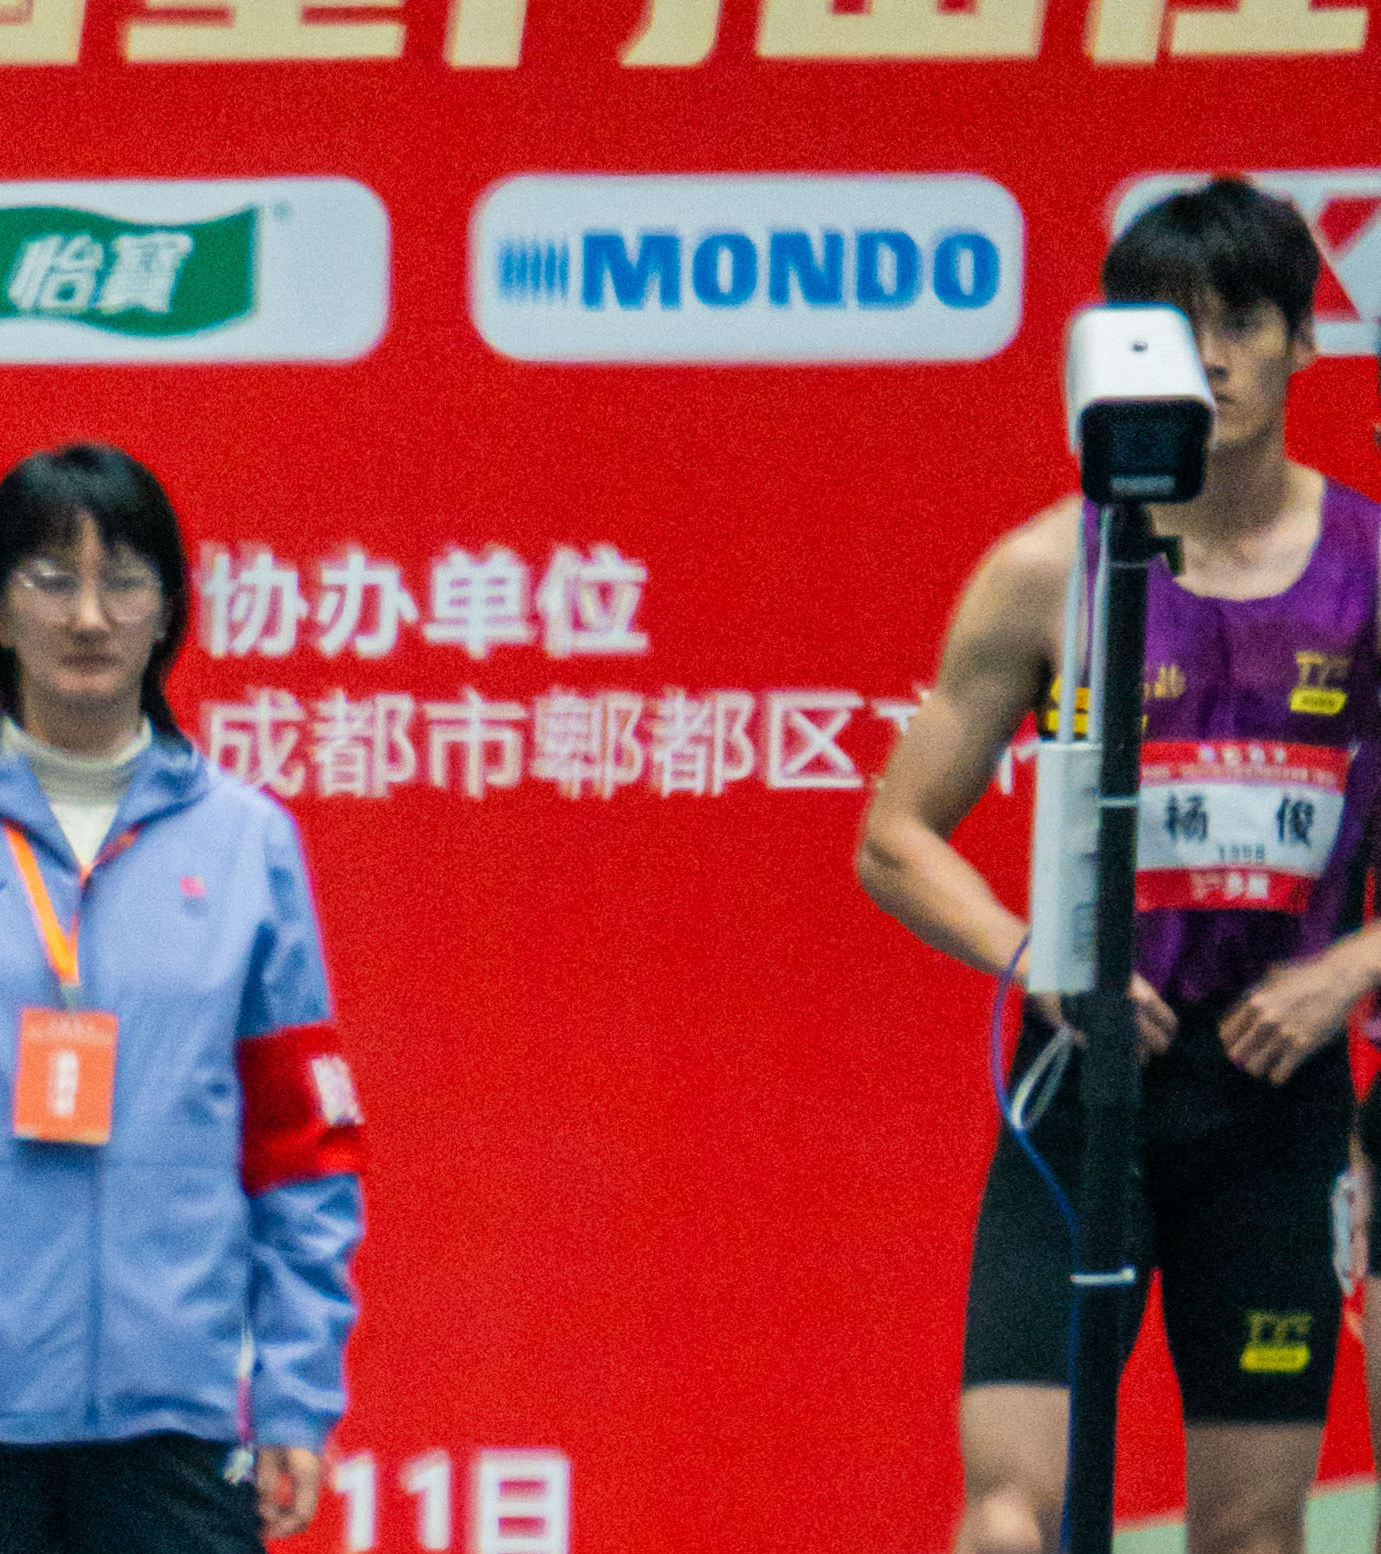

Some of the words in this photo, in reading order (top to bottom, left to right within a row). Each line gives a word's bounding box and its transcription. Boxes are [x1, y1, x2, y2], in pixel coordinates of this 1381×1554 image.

[581, 229, 1002, 310] MONDO
[199, 542, 650, 660] 协办单位
